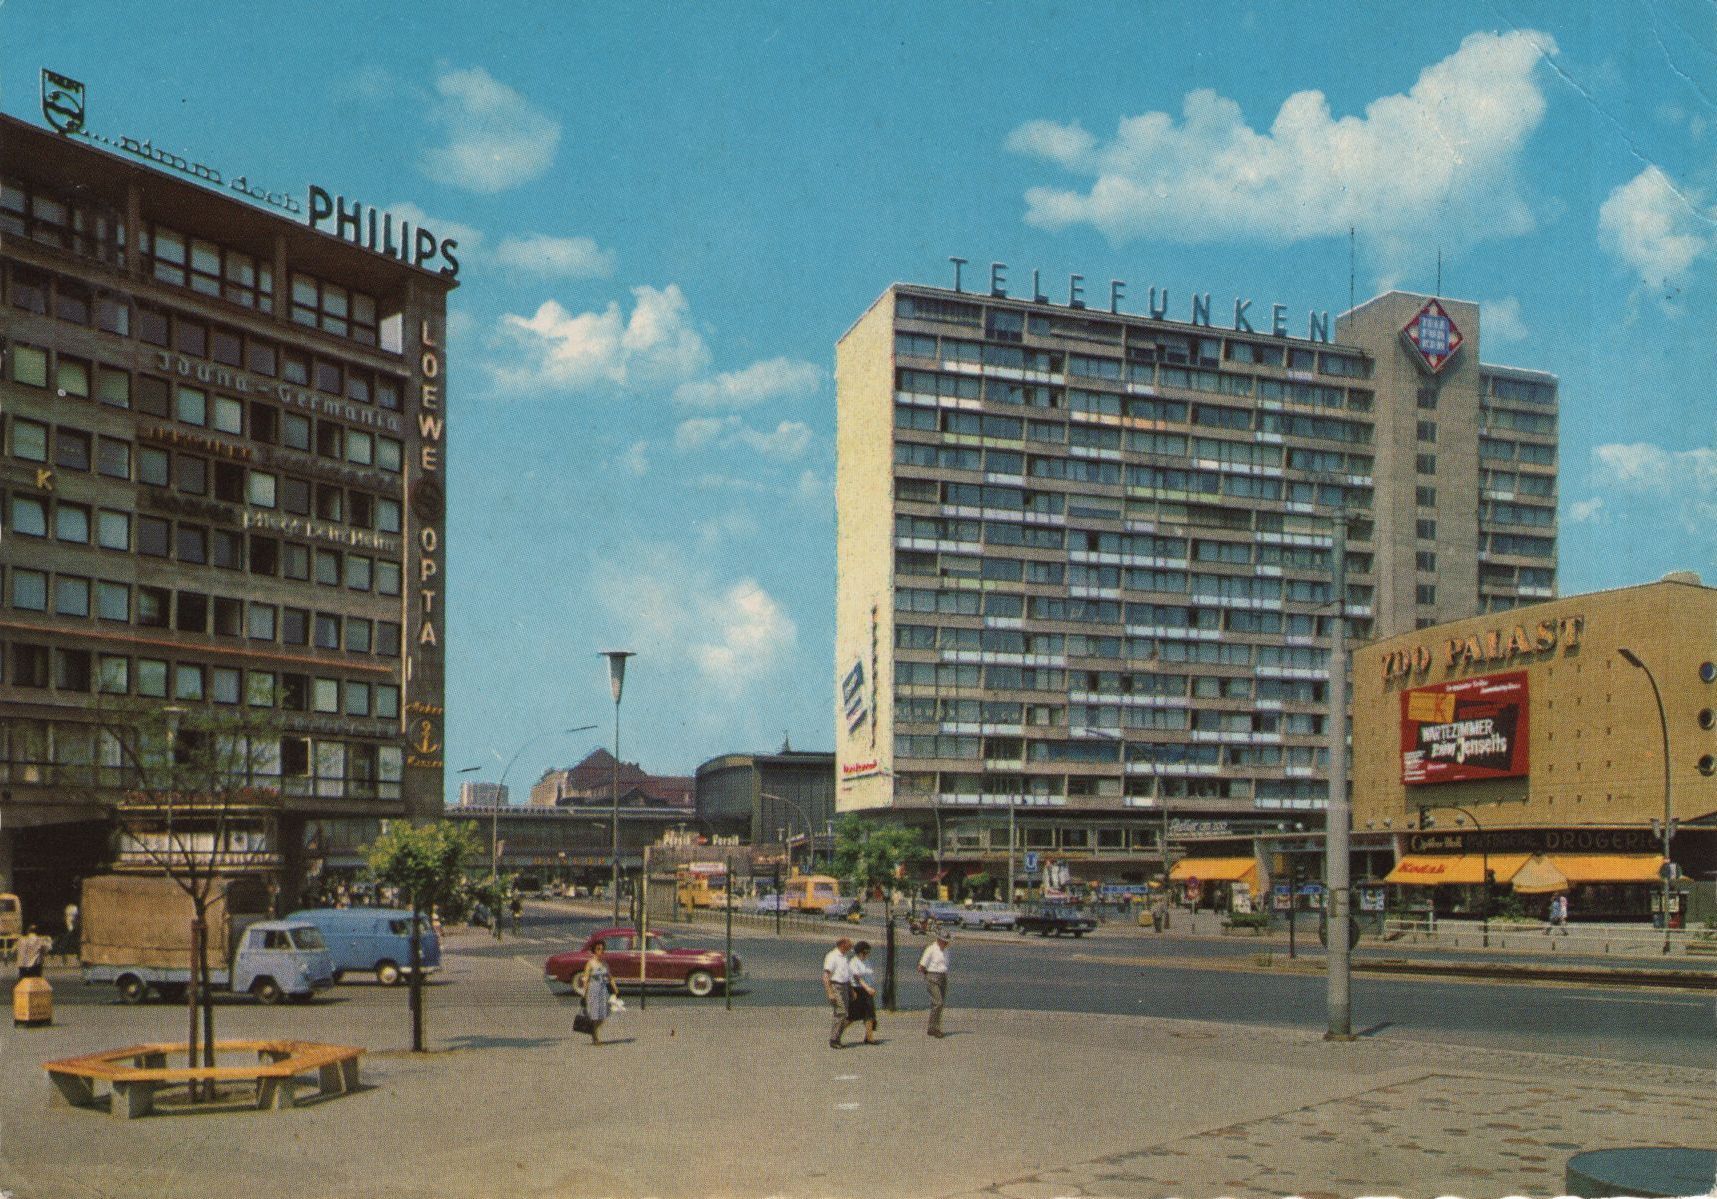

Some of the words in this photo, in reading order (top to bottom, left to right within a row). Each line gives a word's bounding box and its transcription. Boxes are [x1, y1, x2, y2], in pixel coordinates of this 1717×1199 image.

[229, 176, 301, 213] doch
[308, 185, 459, 276] PHILIPS
[949, 256, 1329, 343] TELEFUNKEN
[418, 321, 444, 471] LOEWE
[420, 528, 438, 647] OPTA
[1381, 646, 1431, 679] ZOO
[1445, 615, 1584, 665] PALAST
[1456, 732, 1508, 764] Jenseits
